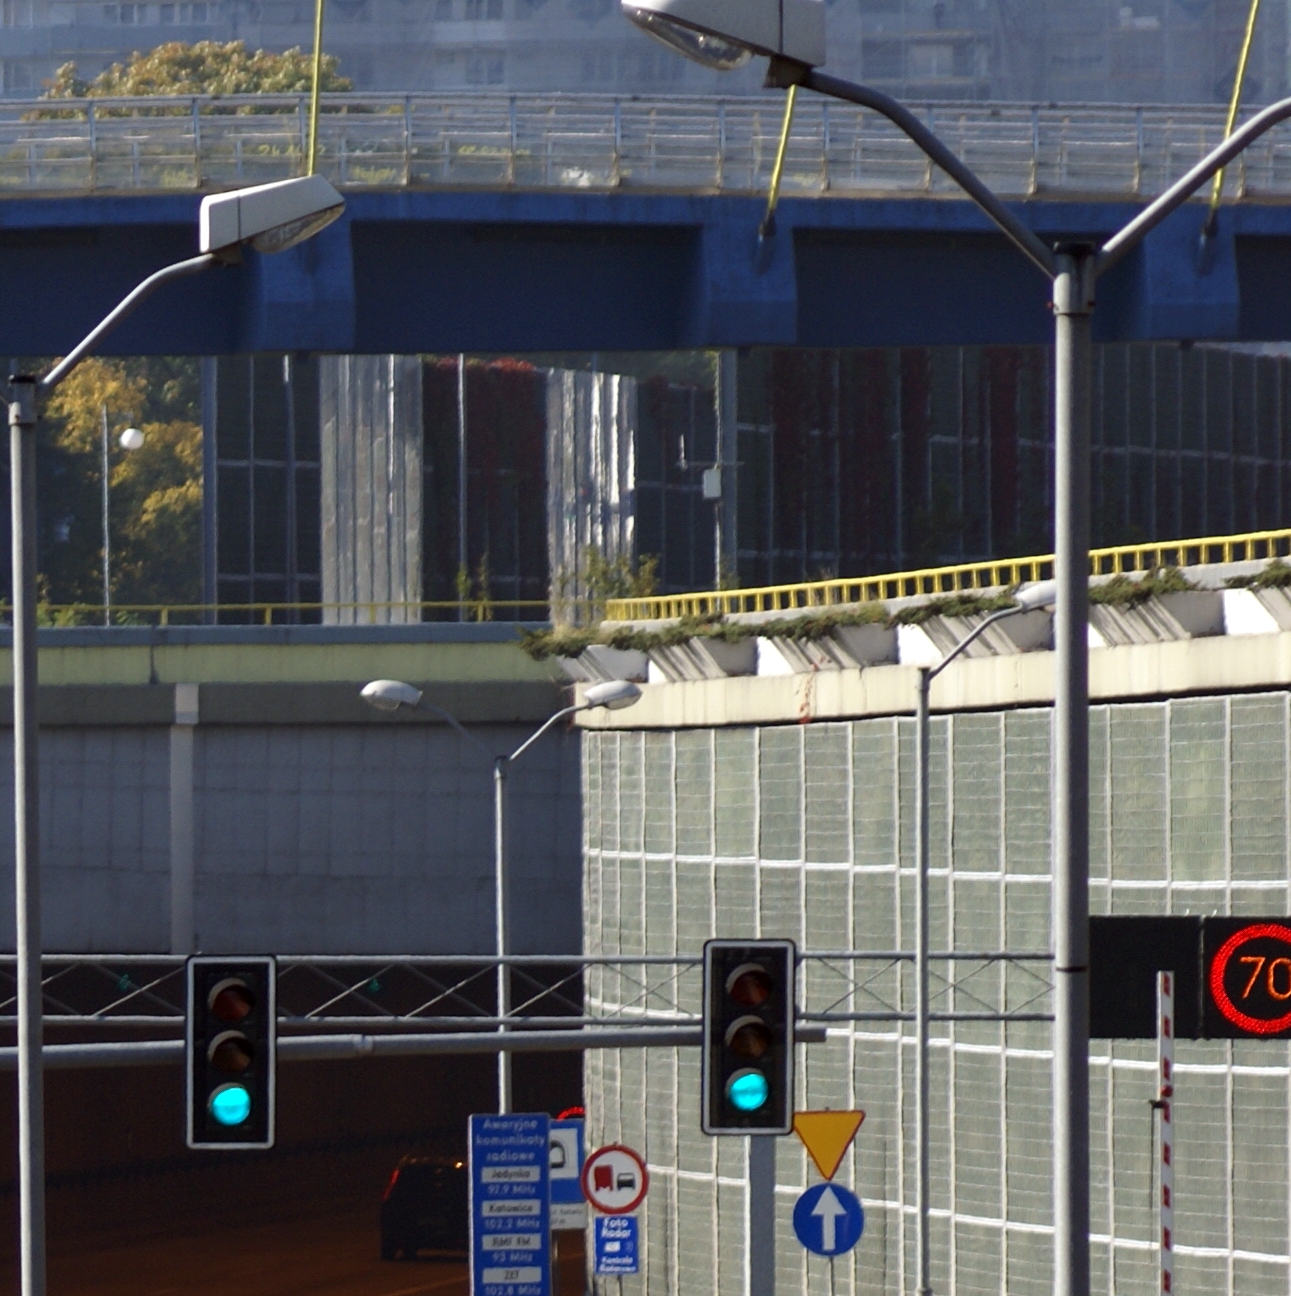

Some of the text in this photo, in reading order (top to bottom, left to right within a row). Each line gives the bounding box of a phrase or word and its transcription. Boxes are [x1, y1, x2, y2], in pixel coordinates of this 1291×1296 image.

[1240, 956, 1291, 1000] 70
[513, 1184, 535, 1194] MHz
[517, 1218, 540, 1228] MHz
[603, 1218, 629, 1228] Foto
[601, 1228, 631, 1238] Radar
[517, 1236, 531, 1246] FM
[492, 1251, 533, 1262] 93 MHz
[519, 1285, 541, 1295] MHz
